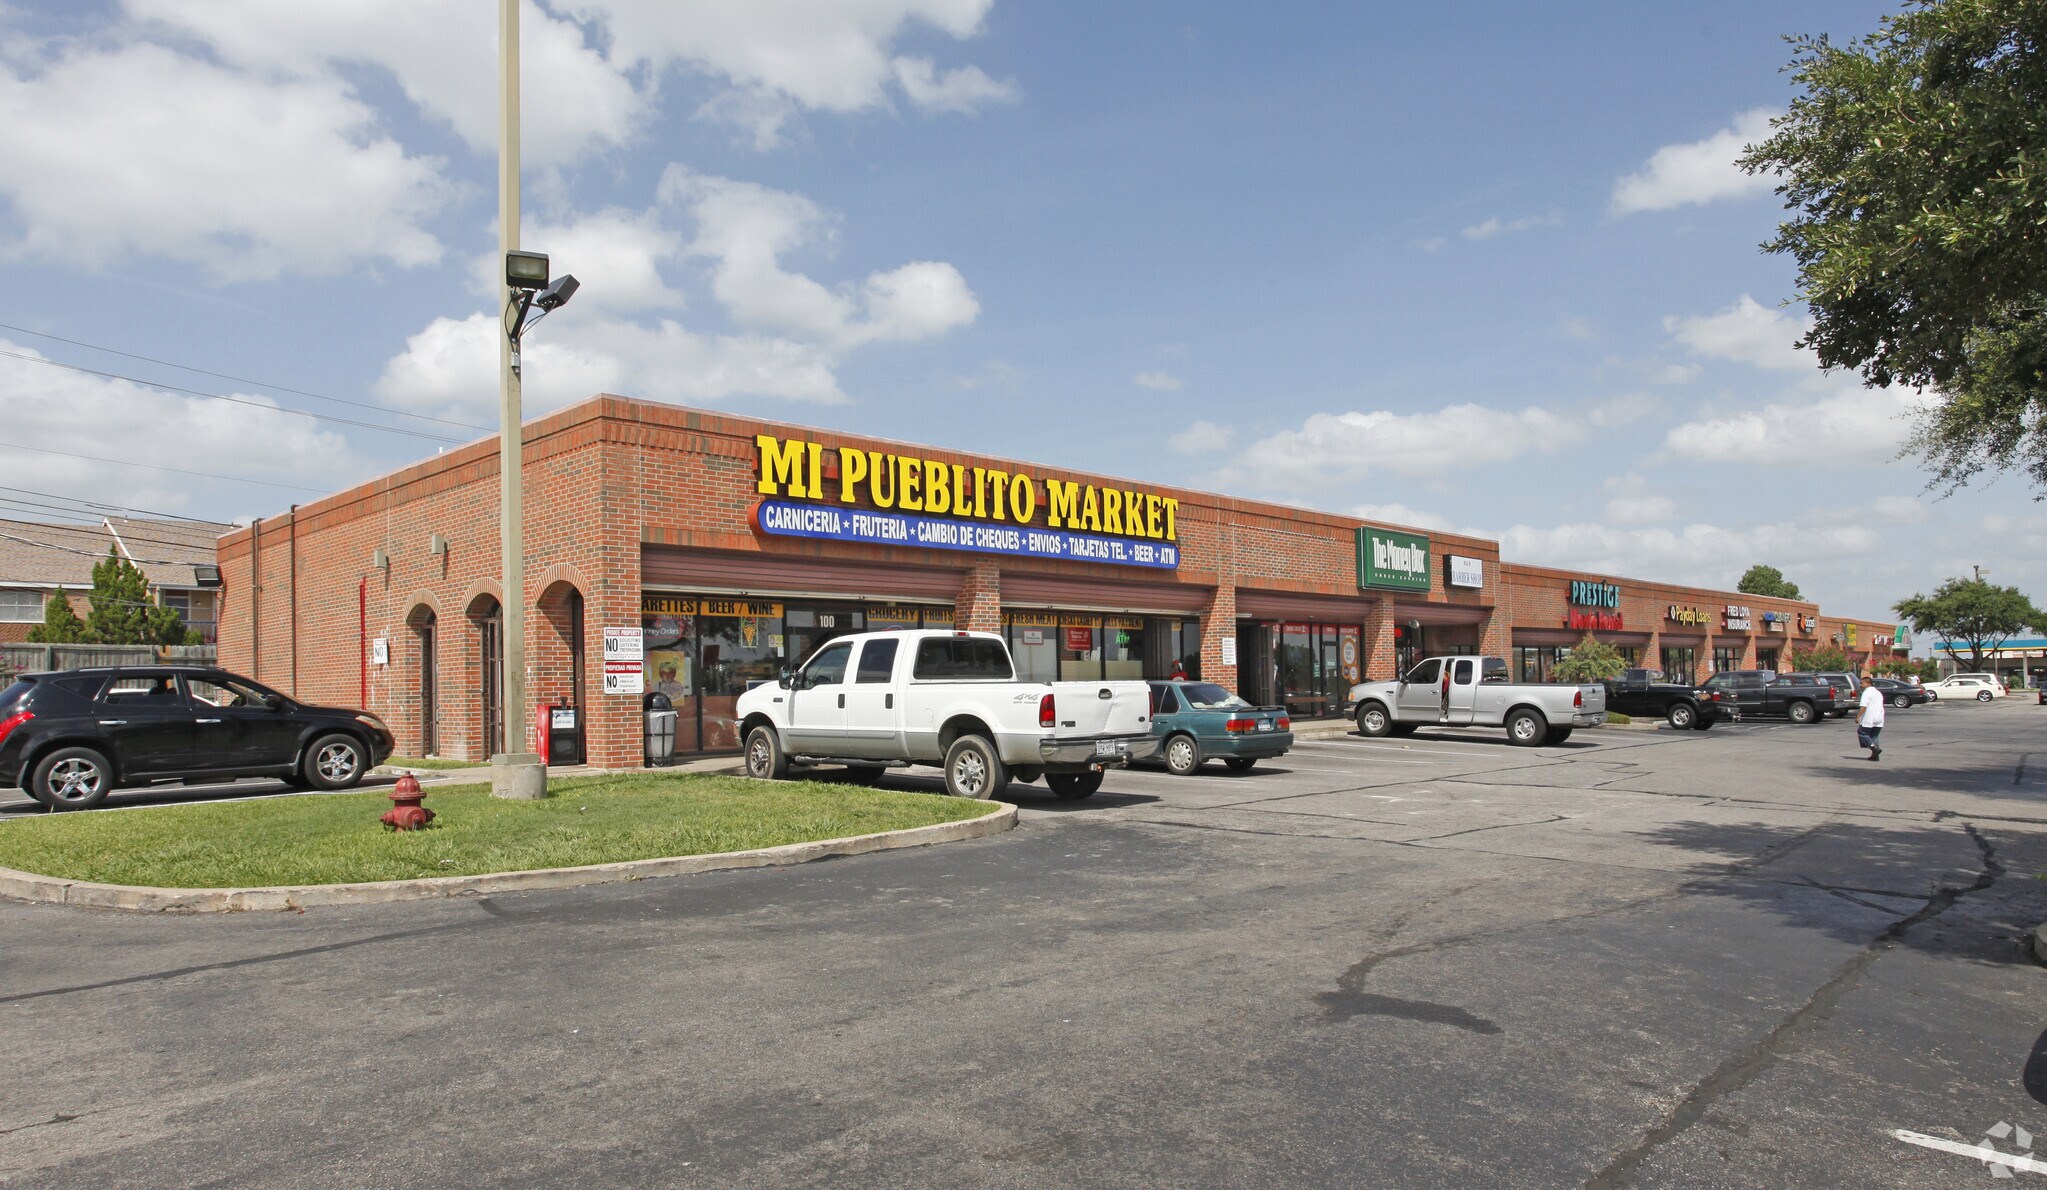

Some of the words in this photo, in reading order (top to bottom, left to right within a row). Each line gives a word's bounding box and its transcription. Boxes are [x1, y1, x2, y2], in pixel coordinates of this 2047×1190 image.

[757, 435, 823, 499] MI
[840, 447, 1035, 524] PUEBLITO
[1047, 479, 1179, 540] MARKET
[765, 506, 841, 534] CARNICERIA
[852, 514, 908, 540] FRUTERIA
[917, 521, 958, 545] CAMBIO
[960, 526, 974, 546] DE
[976, 527, 1020, 550] CHEQUES
[1028, 533, 1061, 554] ENVIOS
[1069, 537, 1109, 559] TARJETAS
[1111, 542, 1128, 560] TEL.
[1134, 544, 1154, 563] BEER
[1160, 547, 1176, 564] ATM
[1372, 537, 1387, 569] The
[1387, 540, 1412, 577] Money
[1411, 543, 1426, 573] Box
[708, 601, 735, 614] BEER
[748, 603, 775, 615] WINE
[868, 608, 915, 620] GROCERY
[924, 609, 954, 621] FRUITS
[1727, 605, 1739, 617] FRED
[820, 615, 835, 628] 100
[1013, 613, 1034, 625] FRESH
[1036, 614, 1056, 625] MEAT
[1676, 605, 1695, 626] Payday
[1696, 607, 1711, 623] Loans
[374, 646, 384, 657] NO
[606, 638, 618, 652] NO
[606, 675, 618, 688] NO
